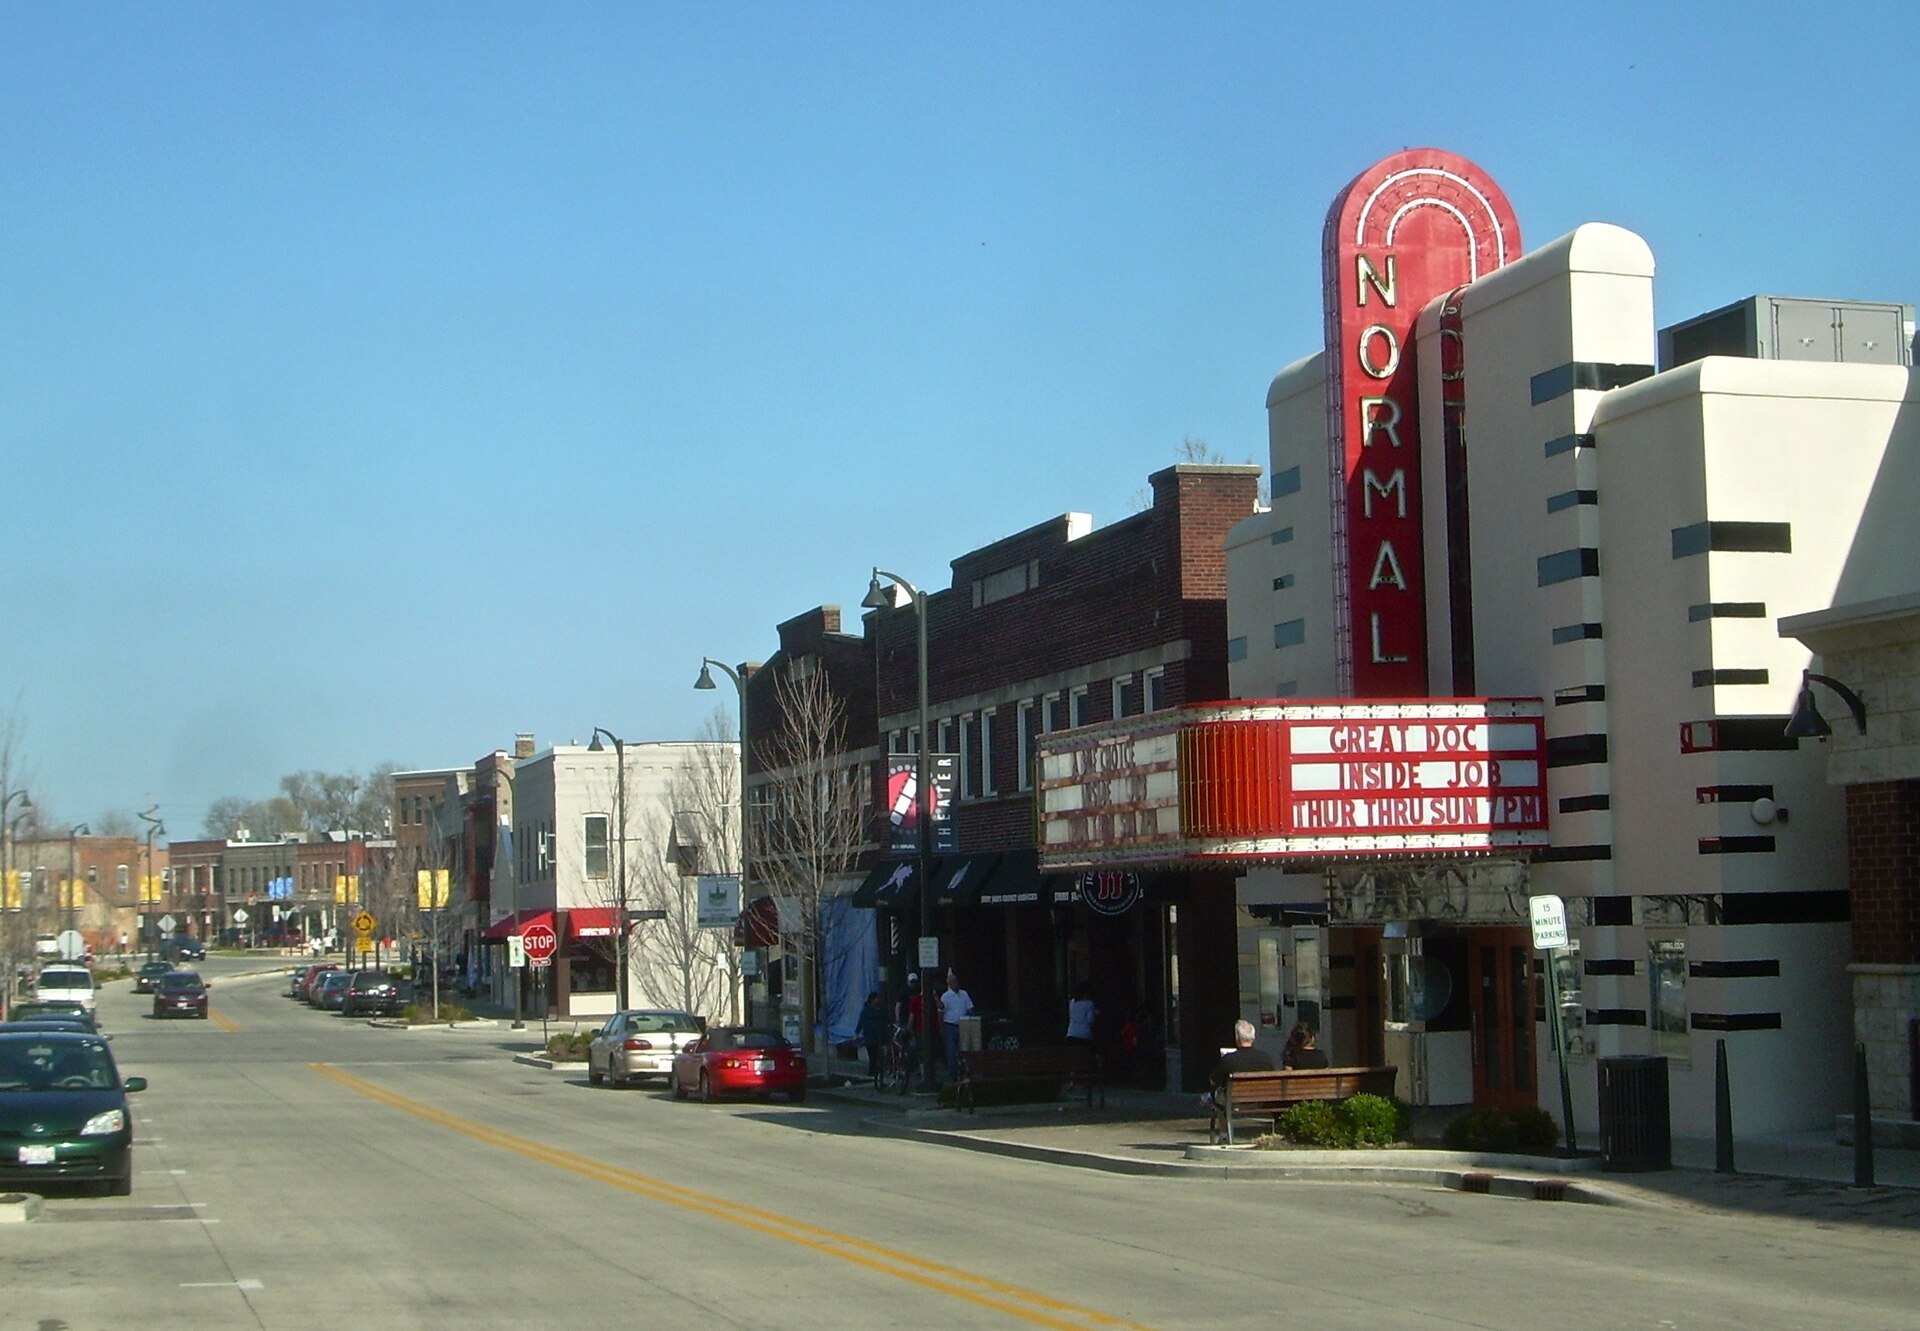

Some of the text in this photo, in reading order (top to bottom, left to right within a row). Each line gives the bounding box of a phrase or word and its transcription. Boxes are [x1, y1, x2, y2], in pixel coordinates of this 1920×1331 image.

[1356, 254, 1408, 664] NORMAL
[1329, 724, 1477, 752] GREAT DOC
[1339, 761, 1502, 790] INSIDE JOB
[935, 758, 952, 849] THEATER
[1291, 799, 1356, 829] THUR
[1364, 797, 1425, 827] THRU
[1430, 797, 1479, 826] SUN
[1535, 916, 1562, 926] MINUTE
[1543, 904, 1551, 913] 15
[524, 935, 554, 950] STOP
[1535, 930, 1566, 940] PARKING
